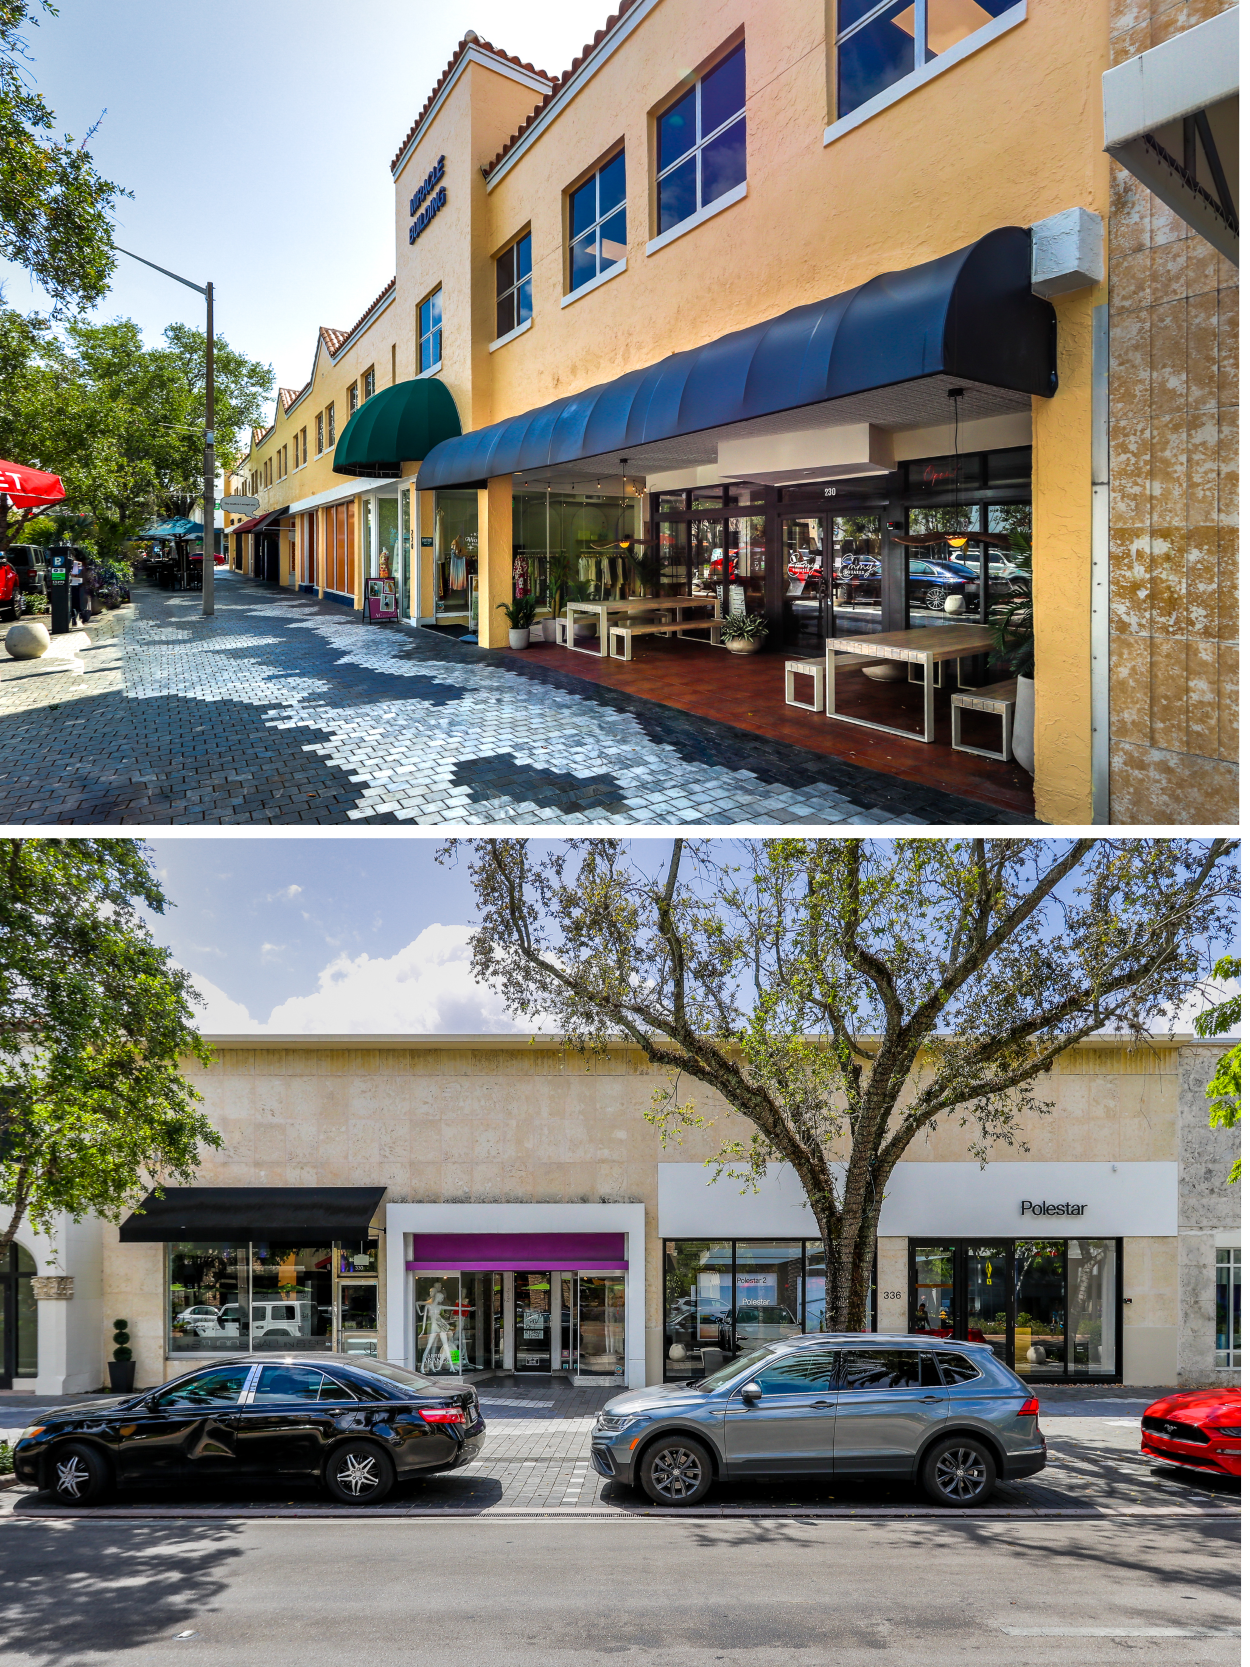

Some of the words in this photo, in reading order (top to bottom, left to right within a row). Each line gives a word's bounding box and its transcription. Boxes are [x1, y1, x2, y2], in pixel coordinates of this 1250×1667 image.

[409, 154, 446, 218] MIRACLE
[409, 186, 447, 246] BUILDING
[824, 487, 837, 497] 230
[839, 553, 882, 579] Emmy
[1020, 1200, 1089, 1216] Polestar
[736, 1276, 762, 1284] Polestar
[762, 1276, 767, 1284] 2
[742, 1297, 771, 1306] Polestar
[883, 1291, 902, 1300] 336
